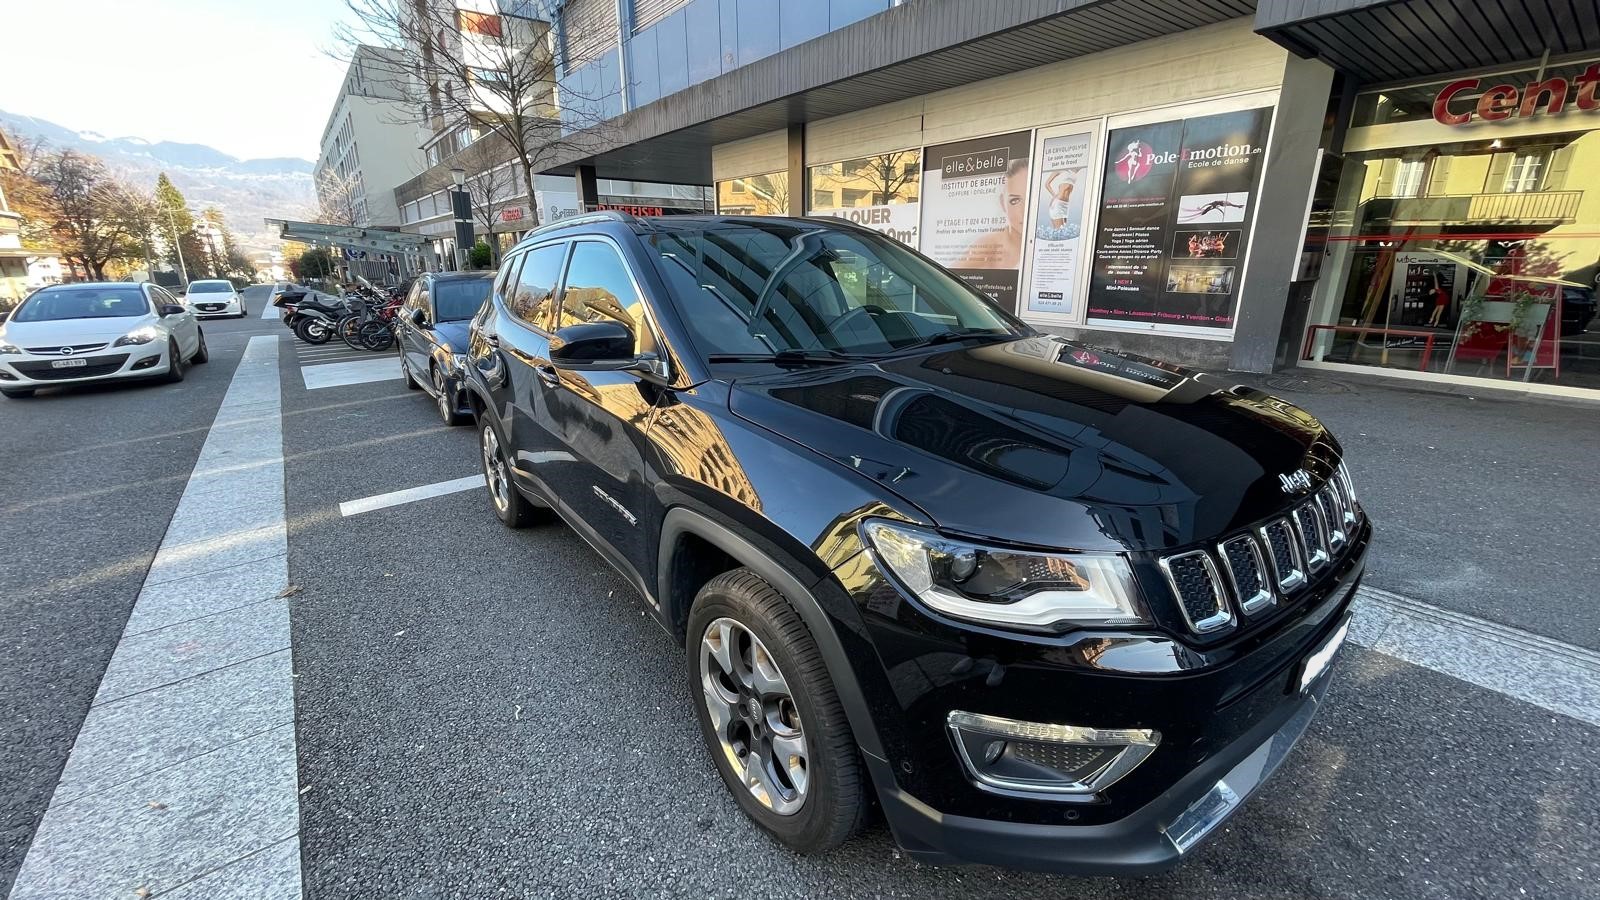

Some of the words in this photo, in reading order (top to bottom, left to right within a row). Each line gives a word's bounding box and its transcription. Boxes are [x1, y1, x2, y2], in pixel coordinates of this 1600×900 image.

[1188, 159, 1210, 168] Ecole
[1224, 157, 1249, 165] danse
[941, 180, 968, 190] INSTITUT
[970, 179, 978, 187] DE
